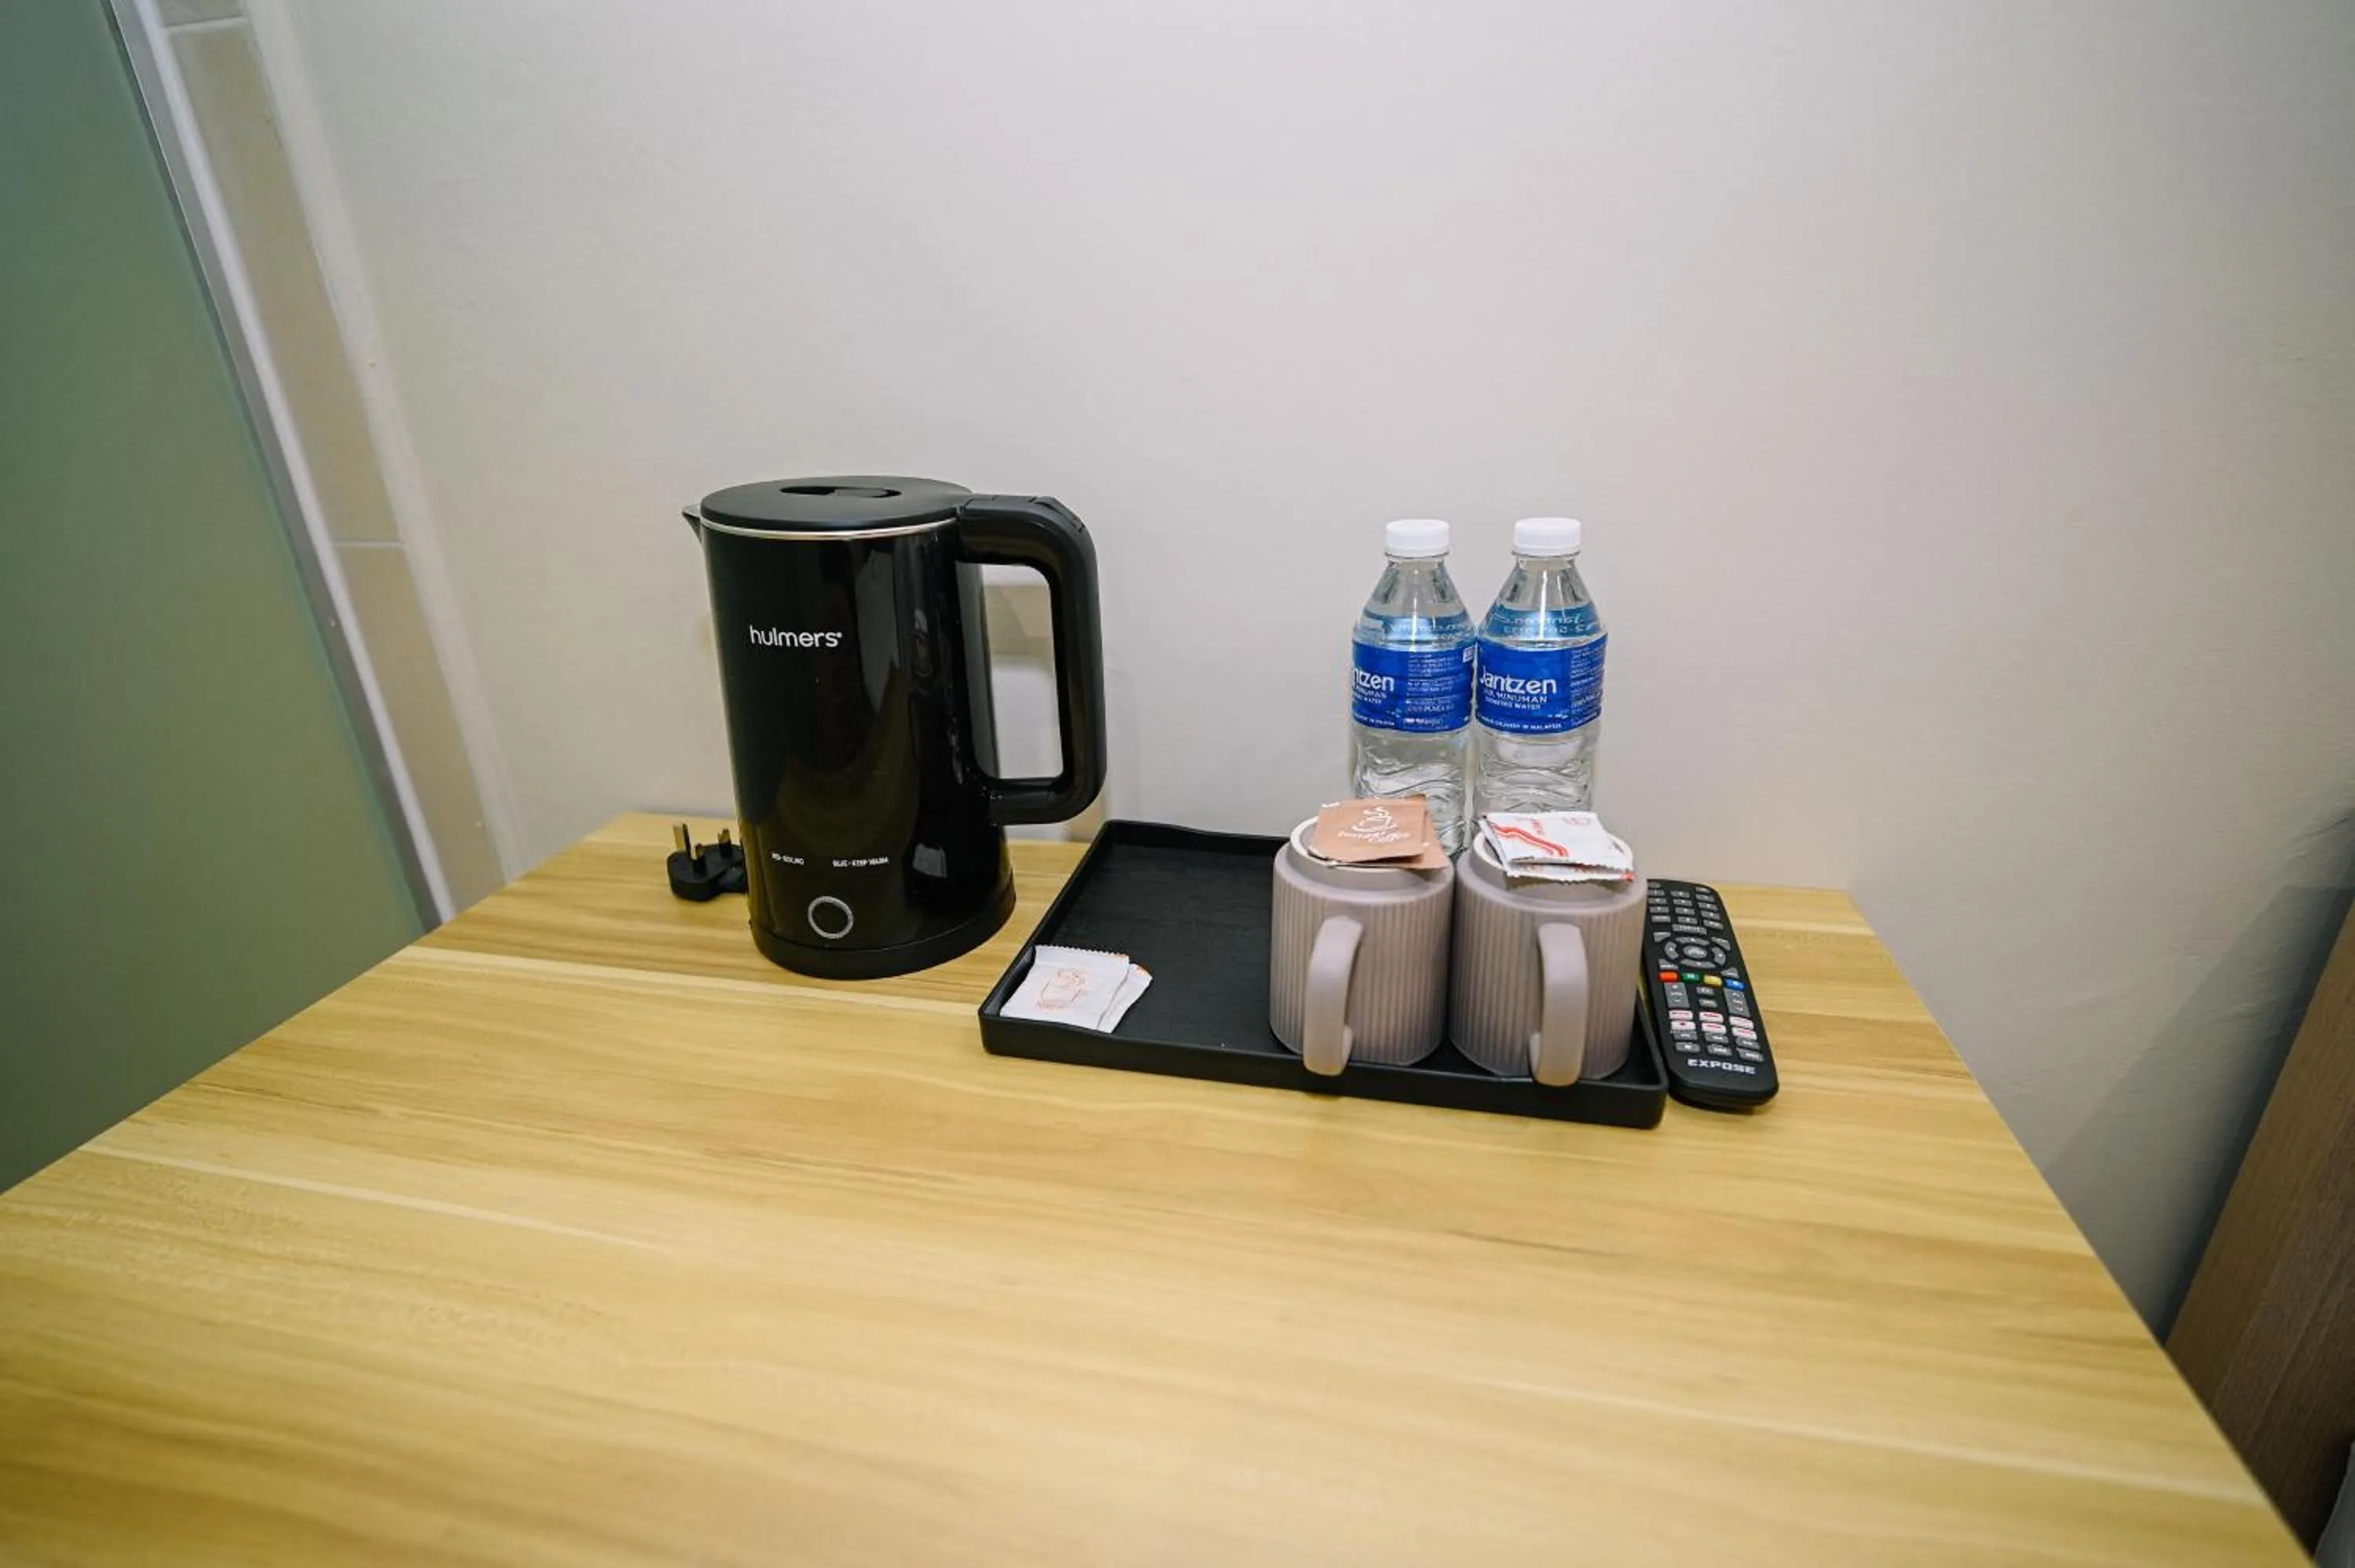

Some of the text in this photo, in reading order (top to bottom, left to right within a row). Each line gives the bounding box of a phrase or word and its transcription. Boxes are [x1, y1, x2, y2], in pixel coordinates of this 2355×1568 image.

[750, 625, 838, 647] hulmers
[1480, 665, 1557, 695] Jantzen
[1496, 691, 1547, 704] MINUMAN
[1688, 1059, 1756, 1074] EXPOSE
